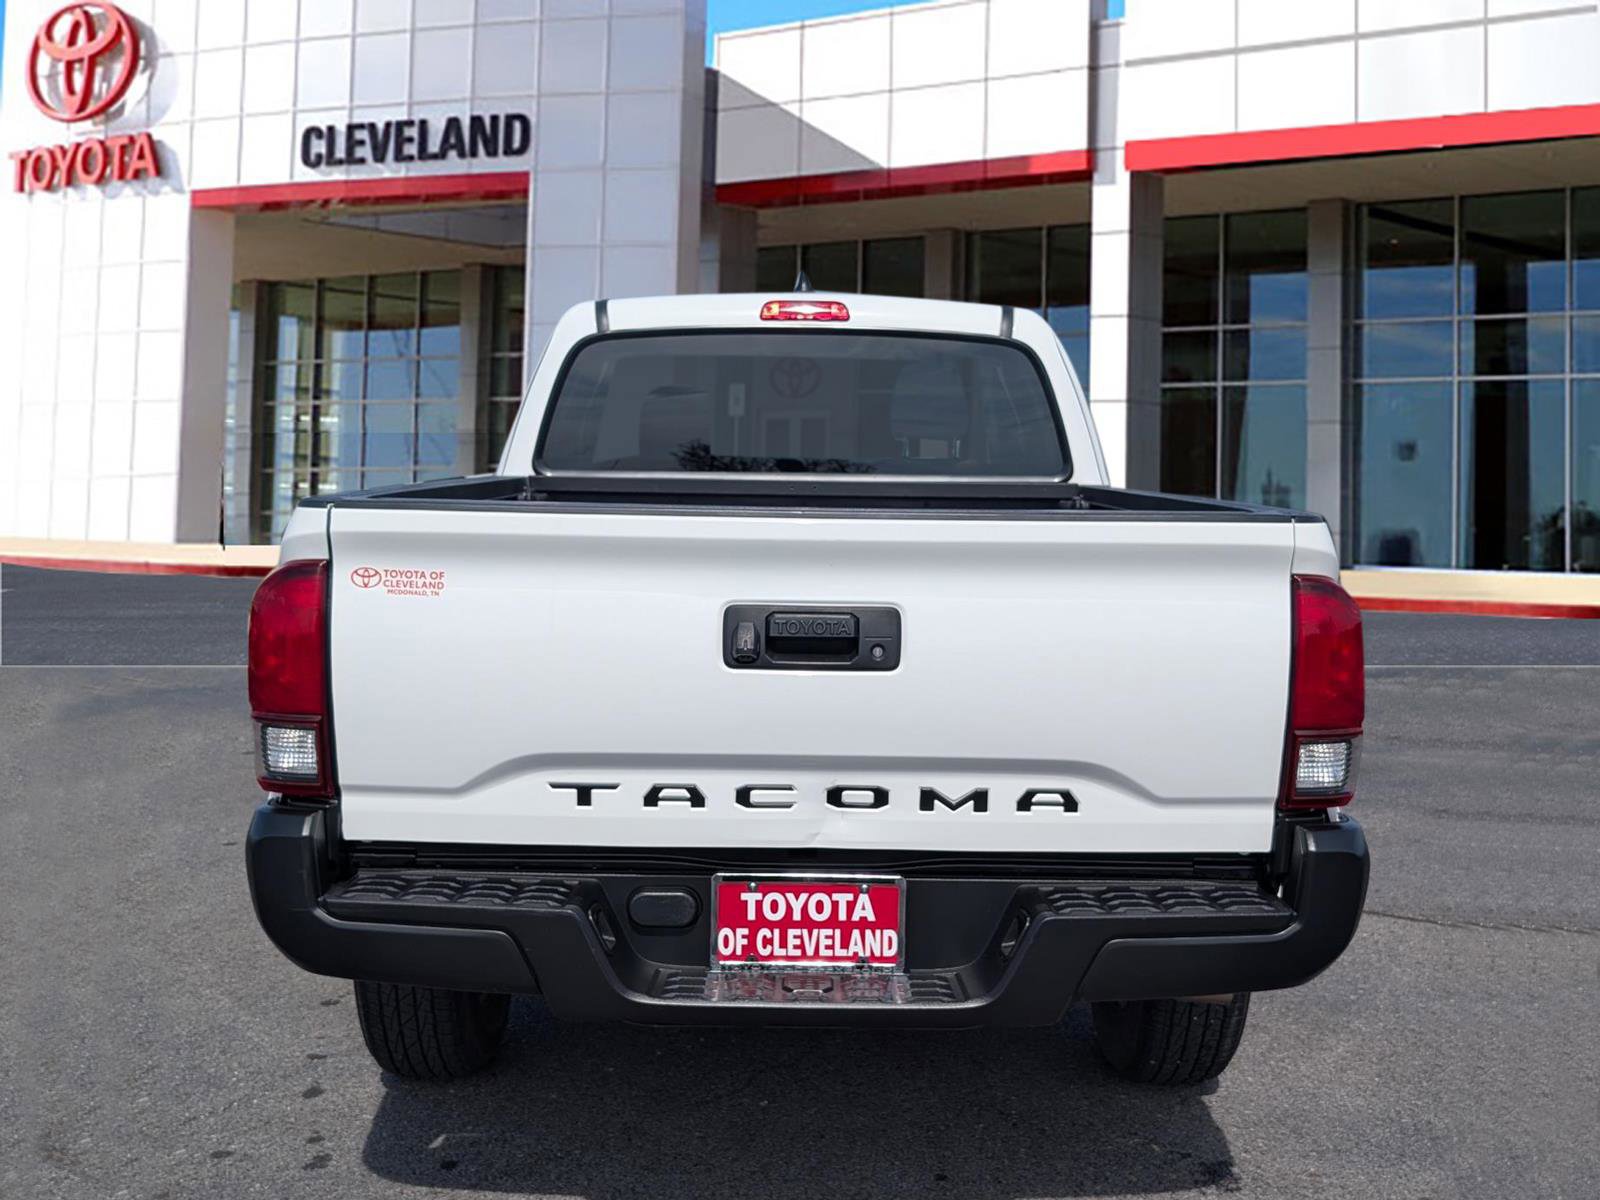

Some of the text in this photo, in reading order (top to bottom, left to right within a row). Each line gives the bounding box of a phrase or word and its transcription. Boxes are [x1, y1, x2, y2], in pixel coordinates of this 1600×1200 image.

[300, 113, 532, 169] CLEVELAND
[10, 131, 161, 193] TOYOTA
[383, 569, 445, 581] TOYOTA OF
[383, 579, 445, 590] CLEVELAND
[775, 619, 851, 636] TOYOTA
[547, 781, 1081, 814] TACOMA
[740, 892, 876, 922] TOYOTA
[717, 927, 899, 957] OF CLEVELAND
